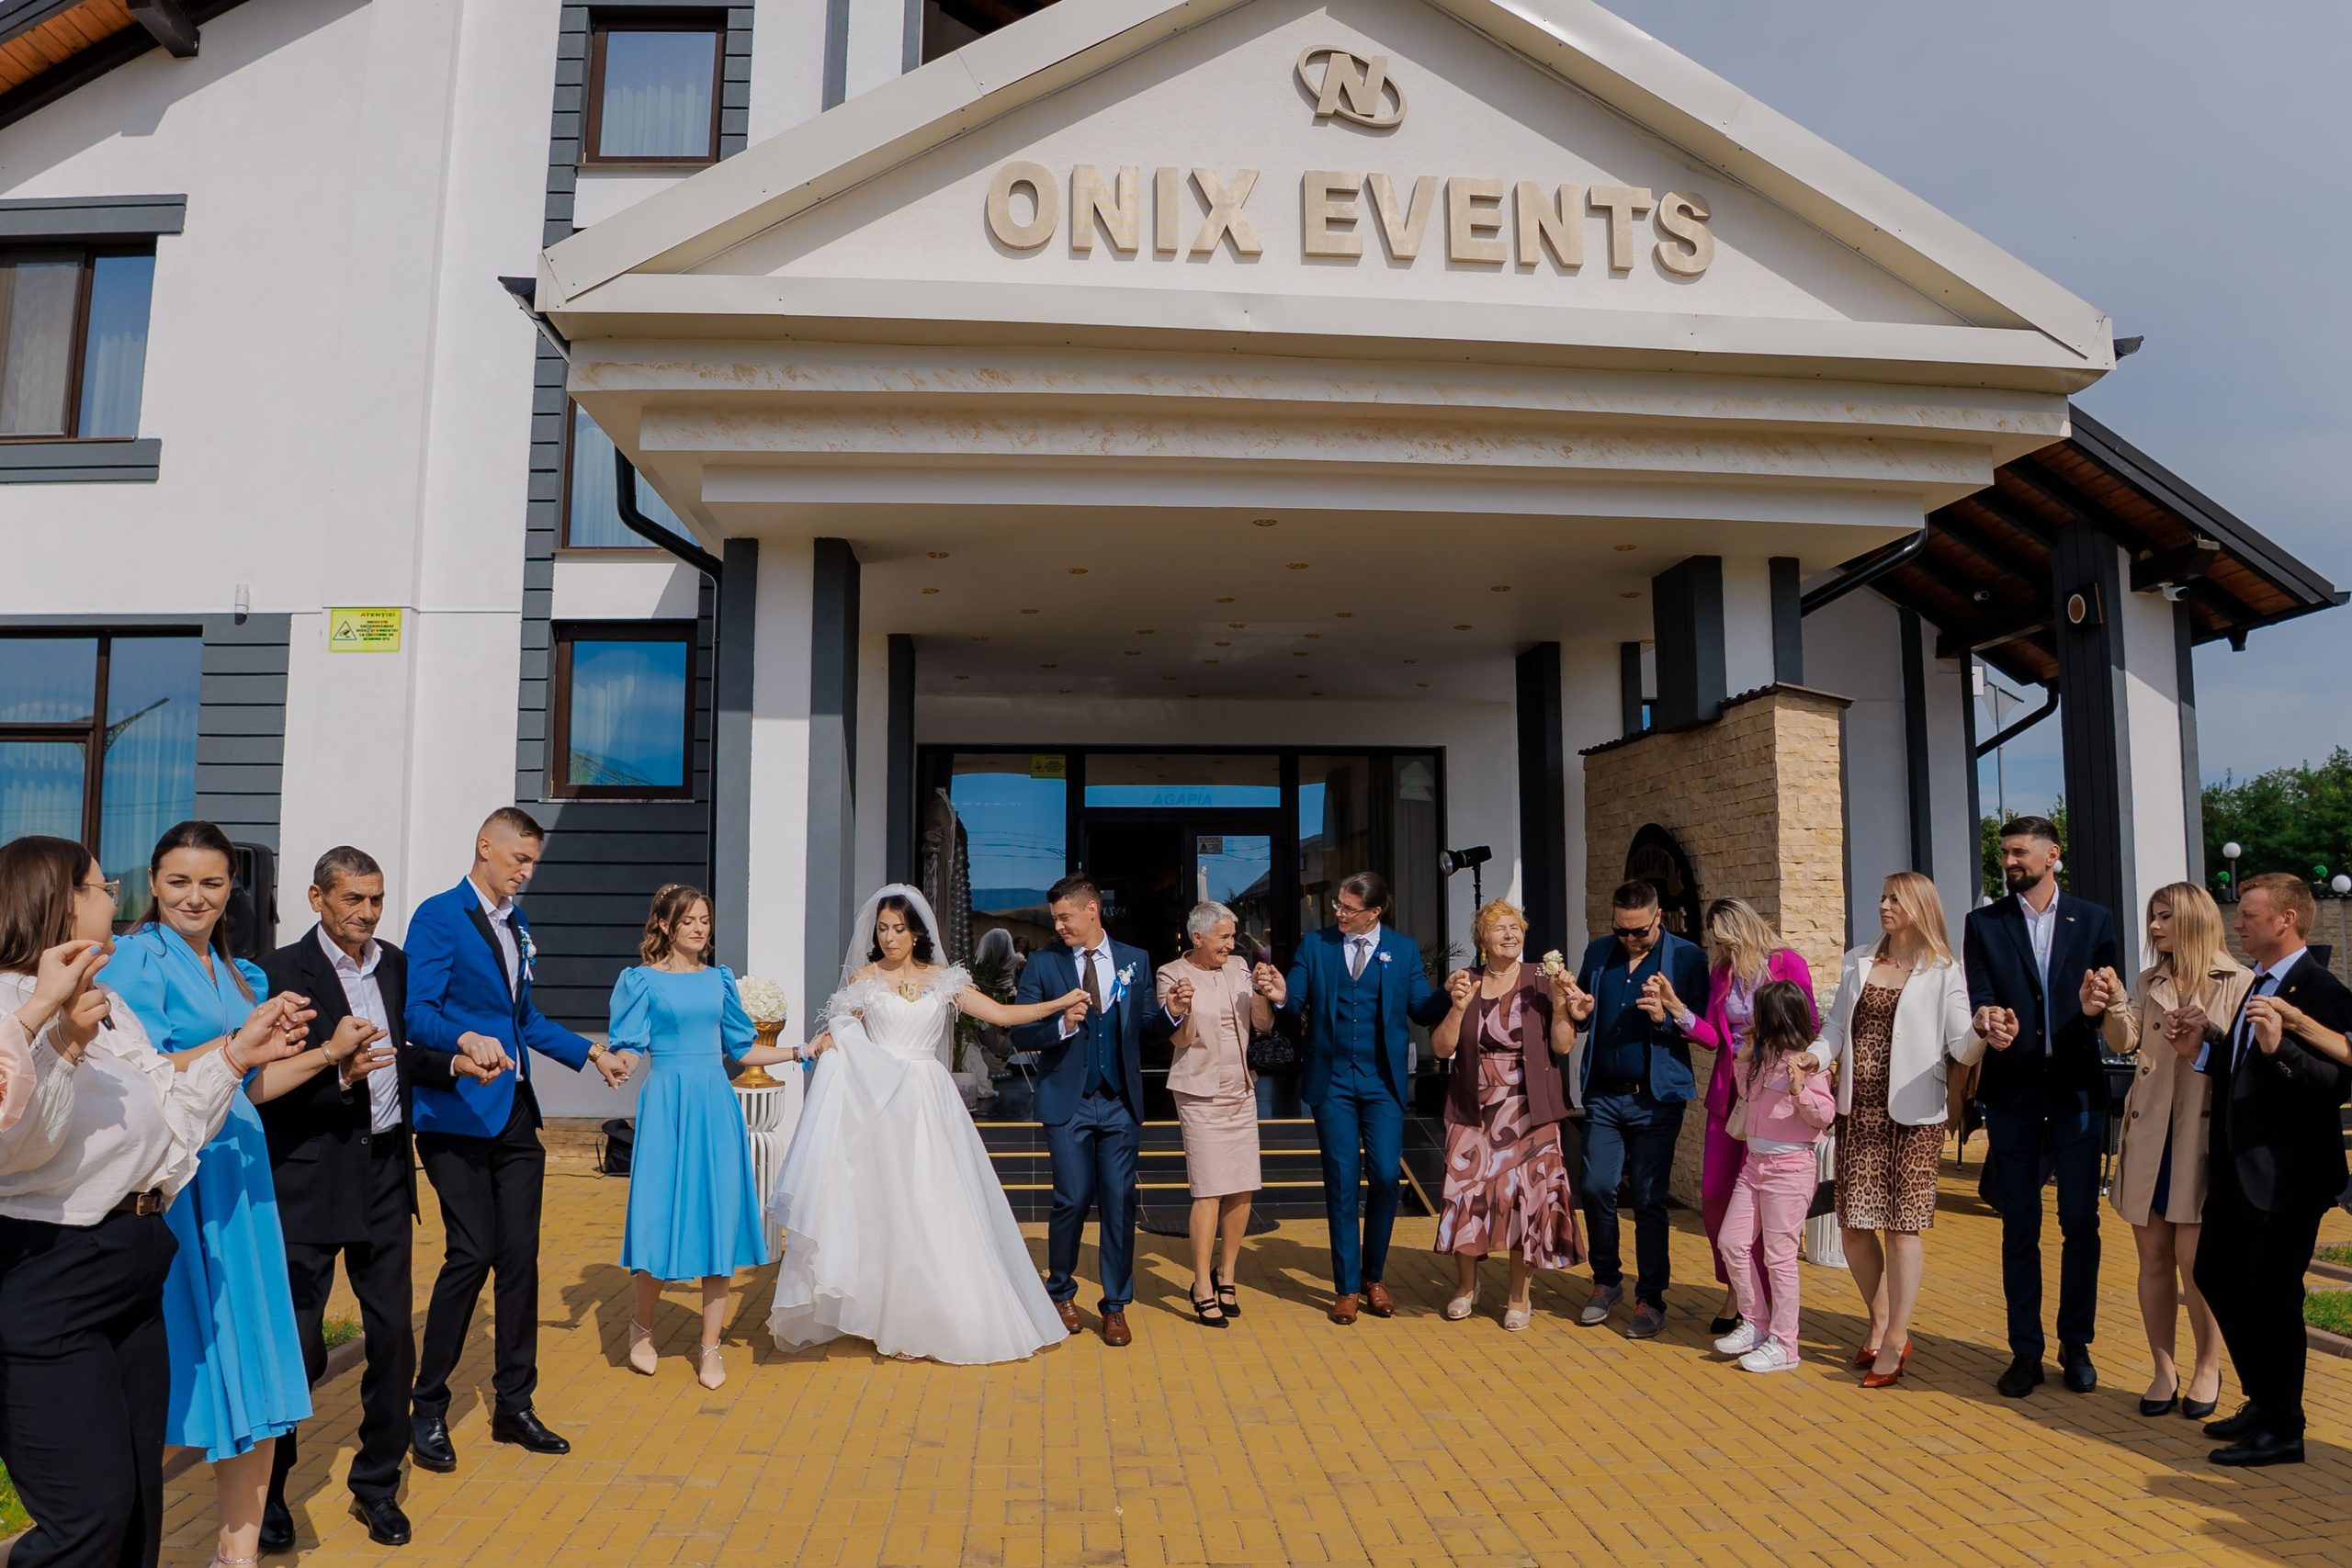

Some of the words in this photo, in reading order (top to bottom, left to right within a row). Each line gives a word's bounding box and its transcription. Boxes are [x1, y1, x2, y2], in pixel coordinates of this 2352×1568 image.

[987, 161, 1263, 255] ONIX
[1300, 170, 1715, 277] EVENTS
[1152, 793, 1212, 805] AGAPIA
[1634, 850, 1668, 877] AGAPIA
